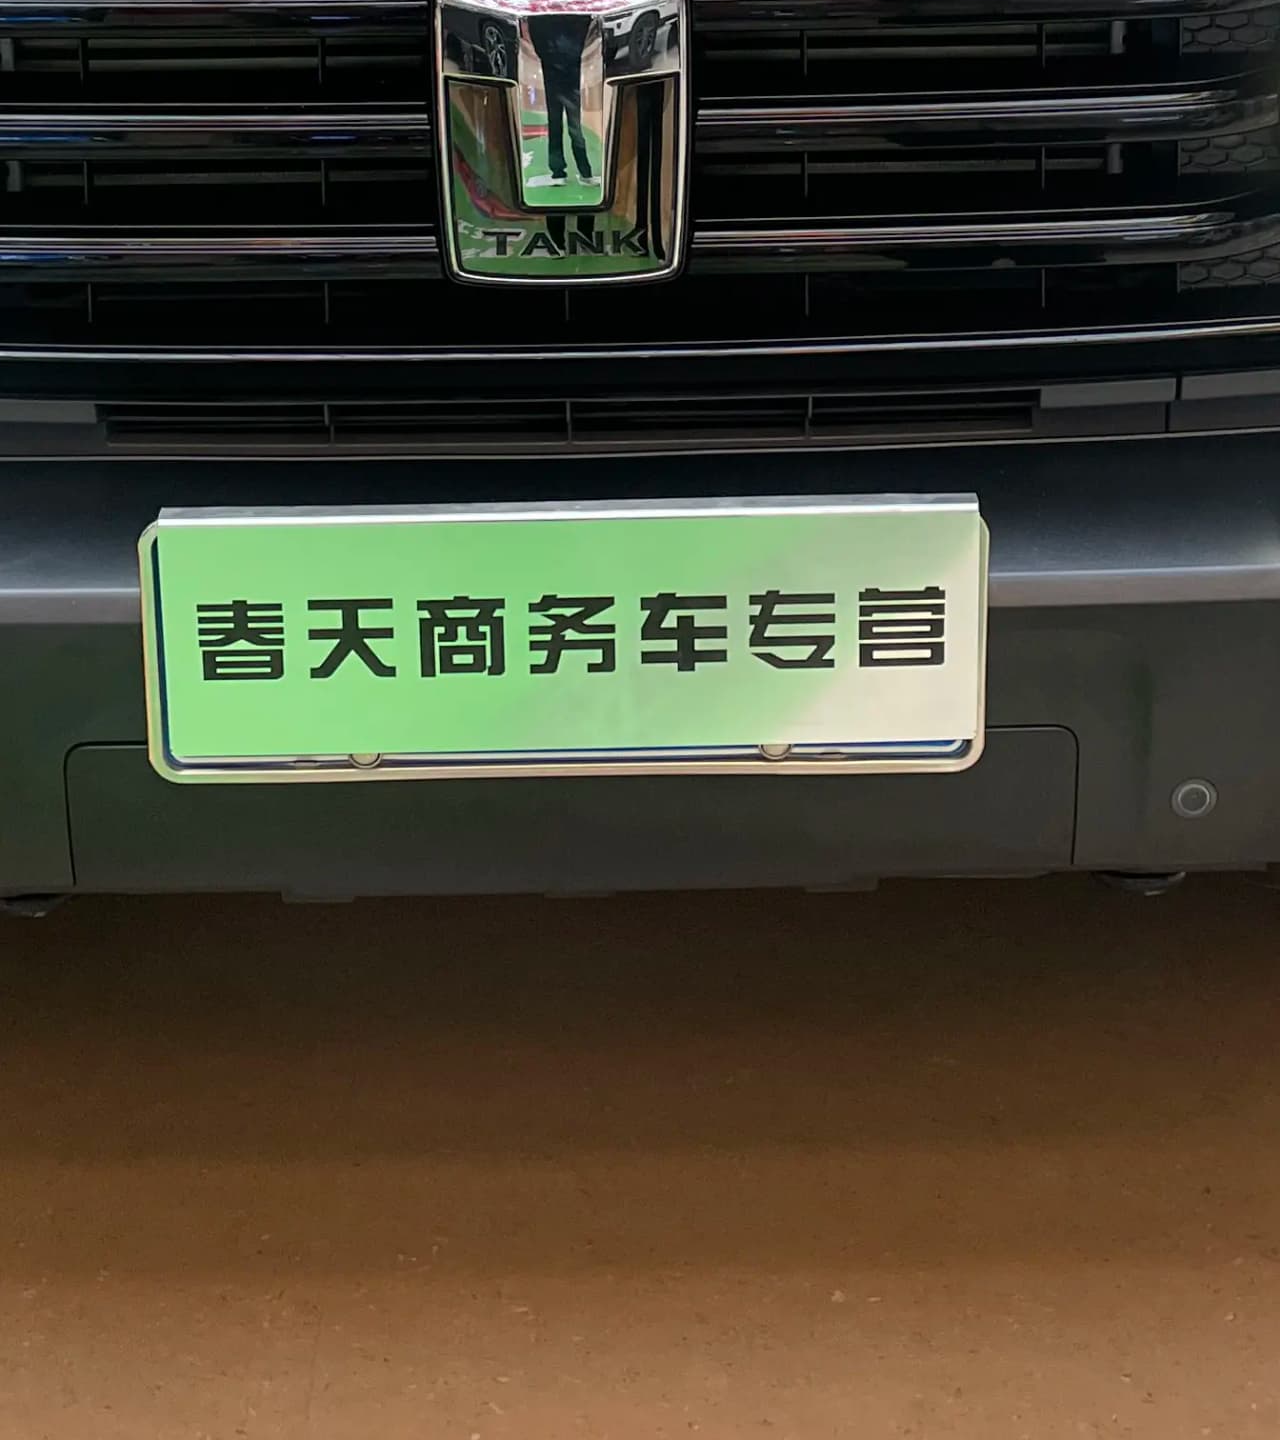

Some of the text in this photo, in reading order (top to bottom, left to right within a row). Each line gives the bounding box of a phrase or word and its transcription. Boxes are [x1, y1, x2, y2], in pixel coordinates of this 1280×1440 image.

[481, 230, 650, 258] TANK
[195, 586, 946, 681] 春天商务车专营
